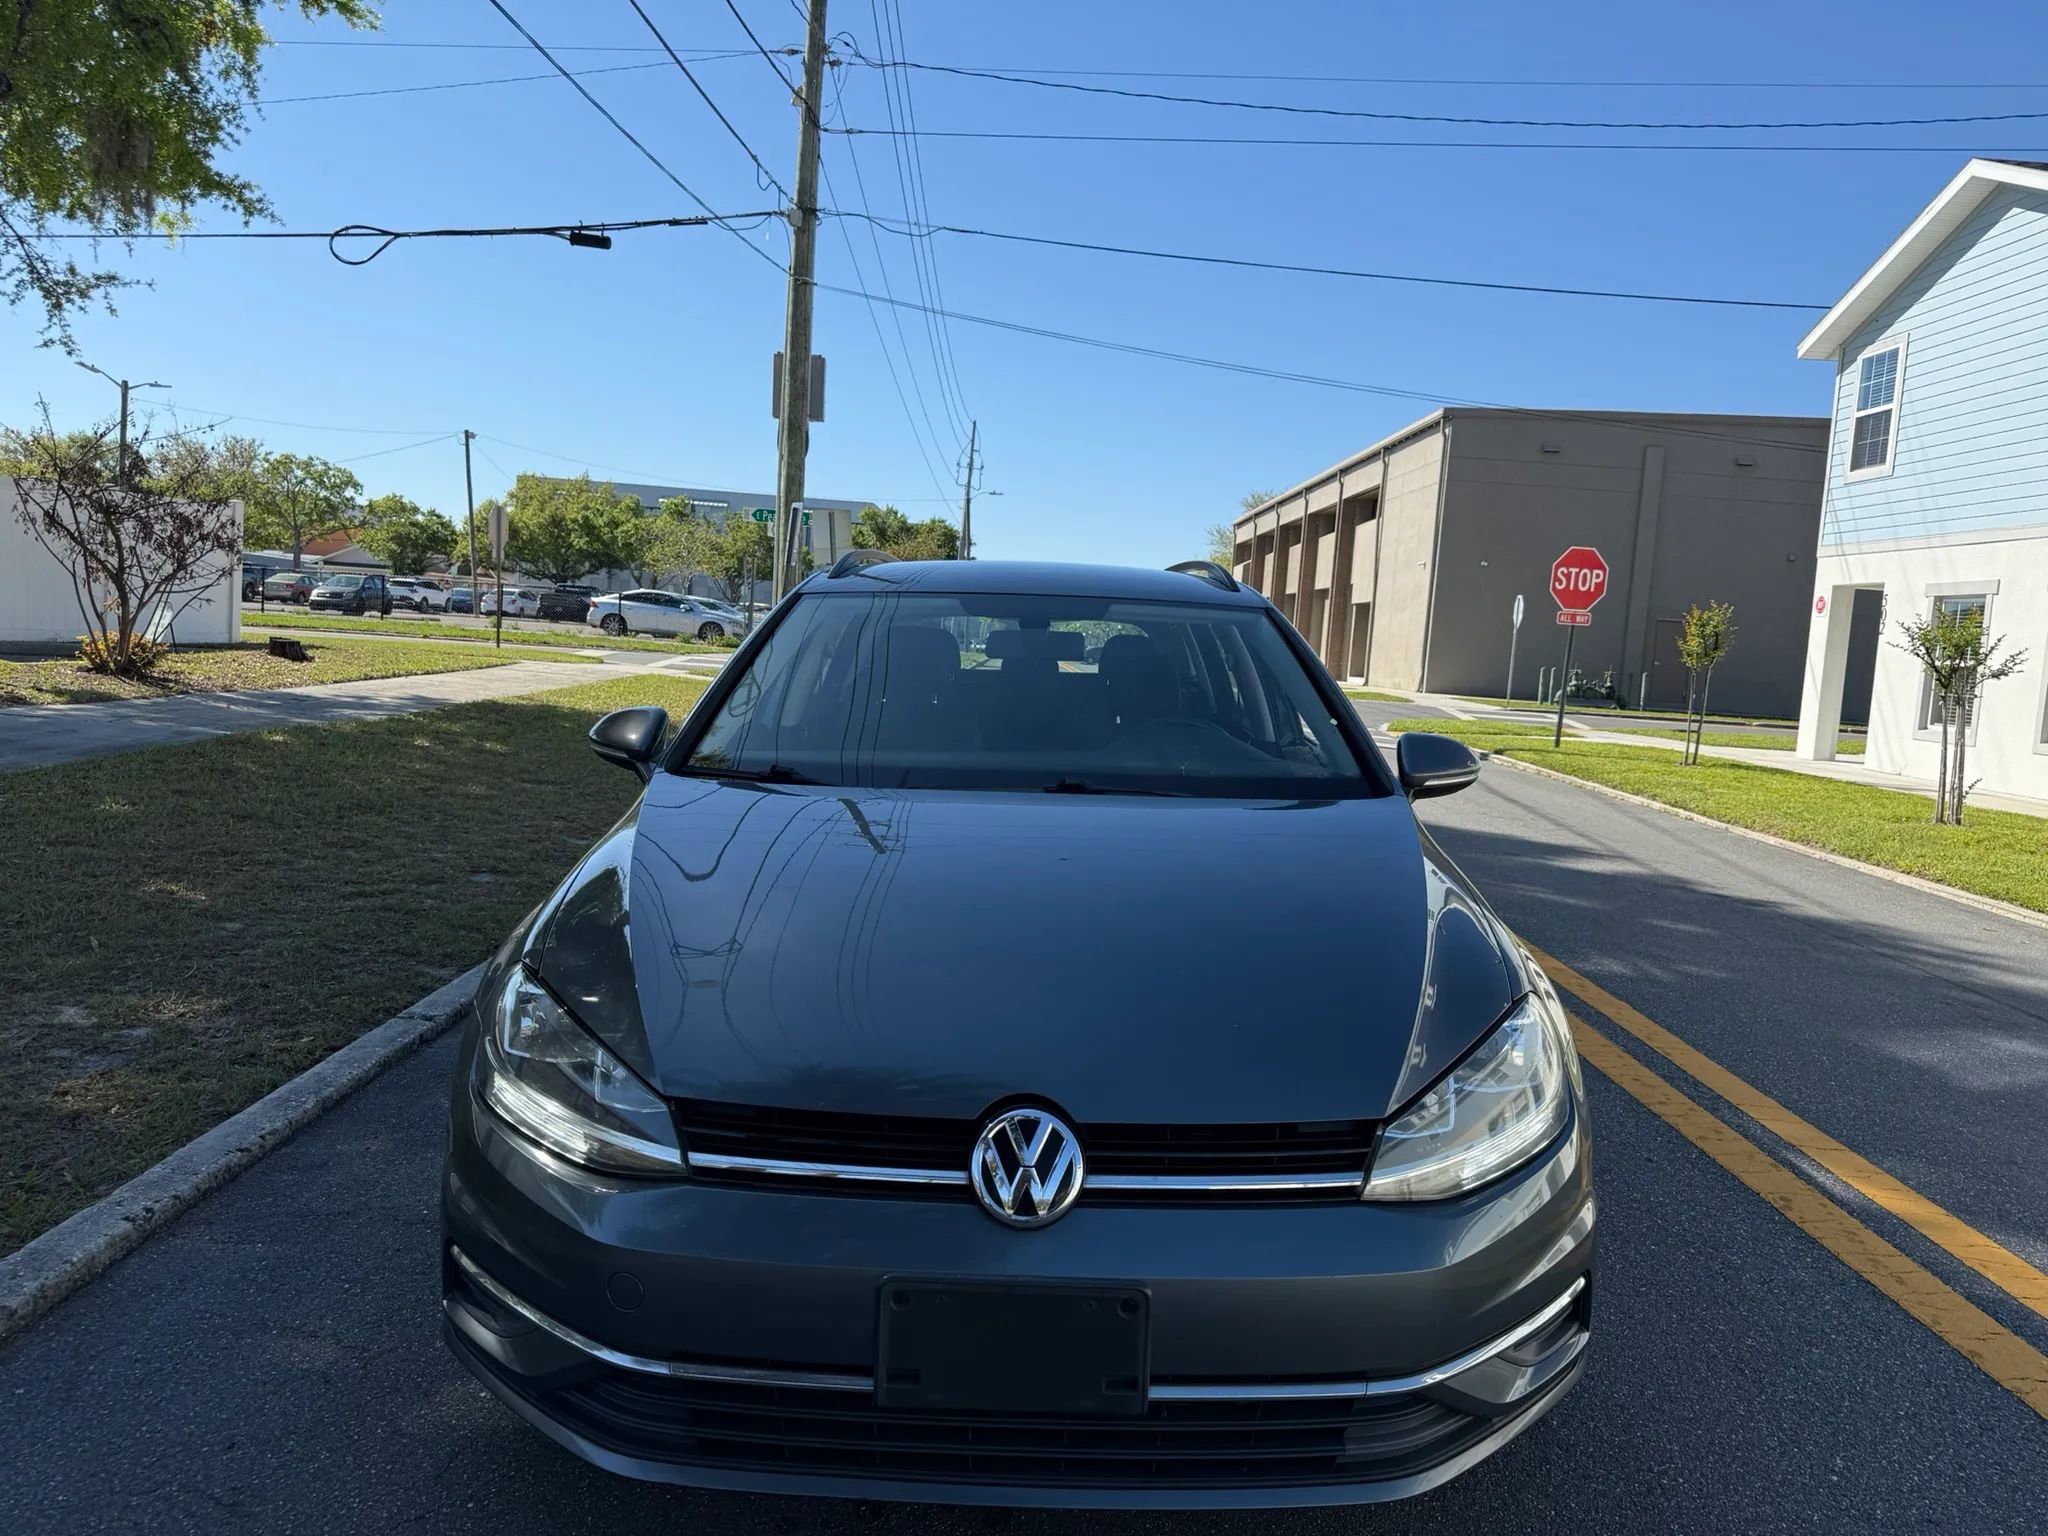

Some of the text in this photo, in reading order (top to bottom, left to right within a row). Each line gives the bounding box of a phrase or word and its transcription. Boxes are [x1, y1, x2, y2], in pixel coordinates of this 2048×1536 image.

[1555, 567, 1604, 592] STOP
[1560, 614, 1589, 623] ALL WAY
[1879, 593, 1889, 635] 502
